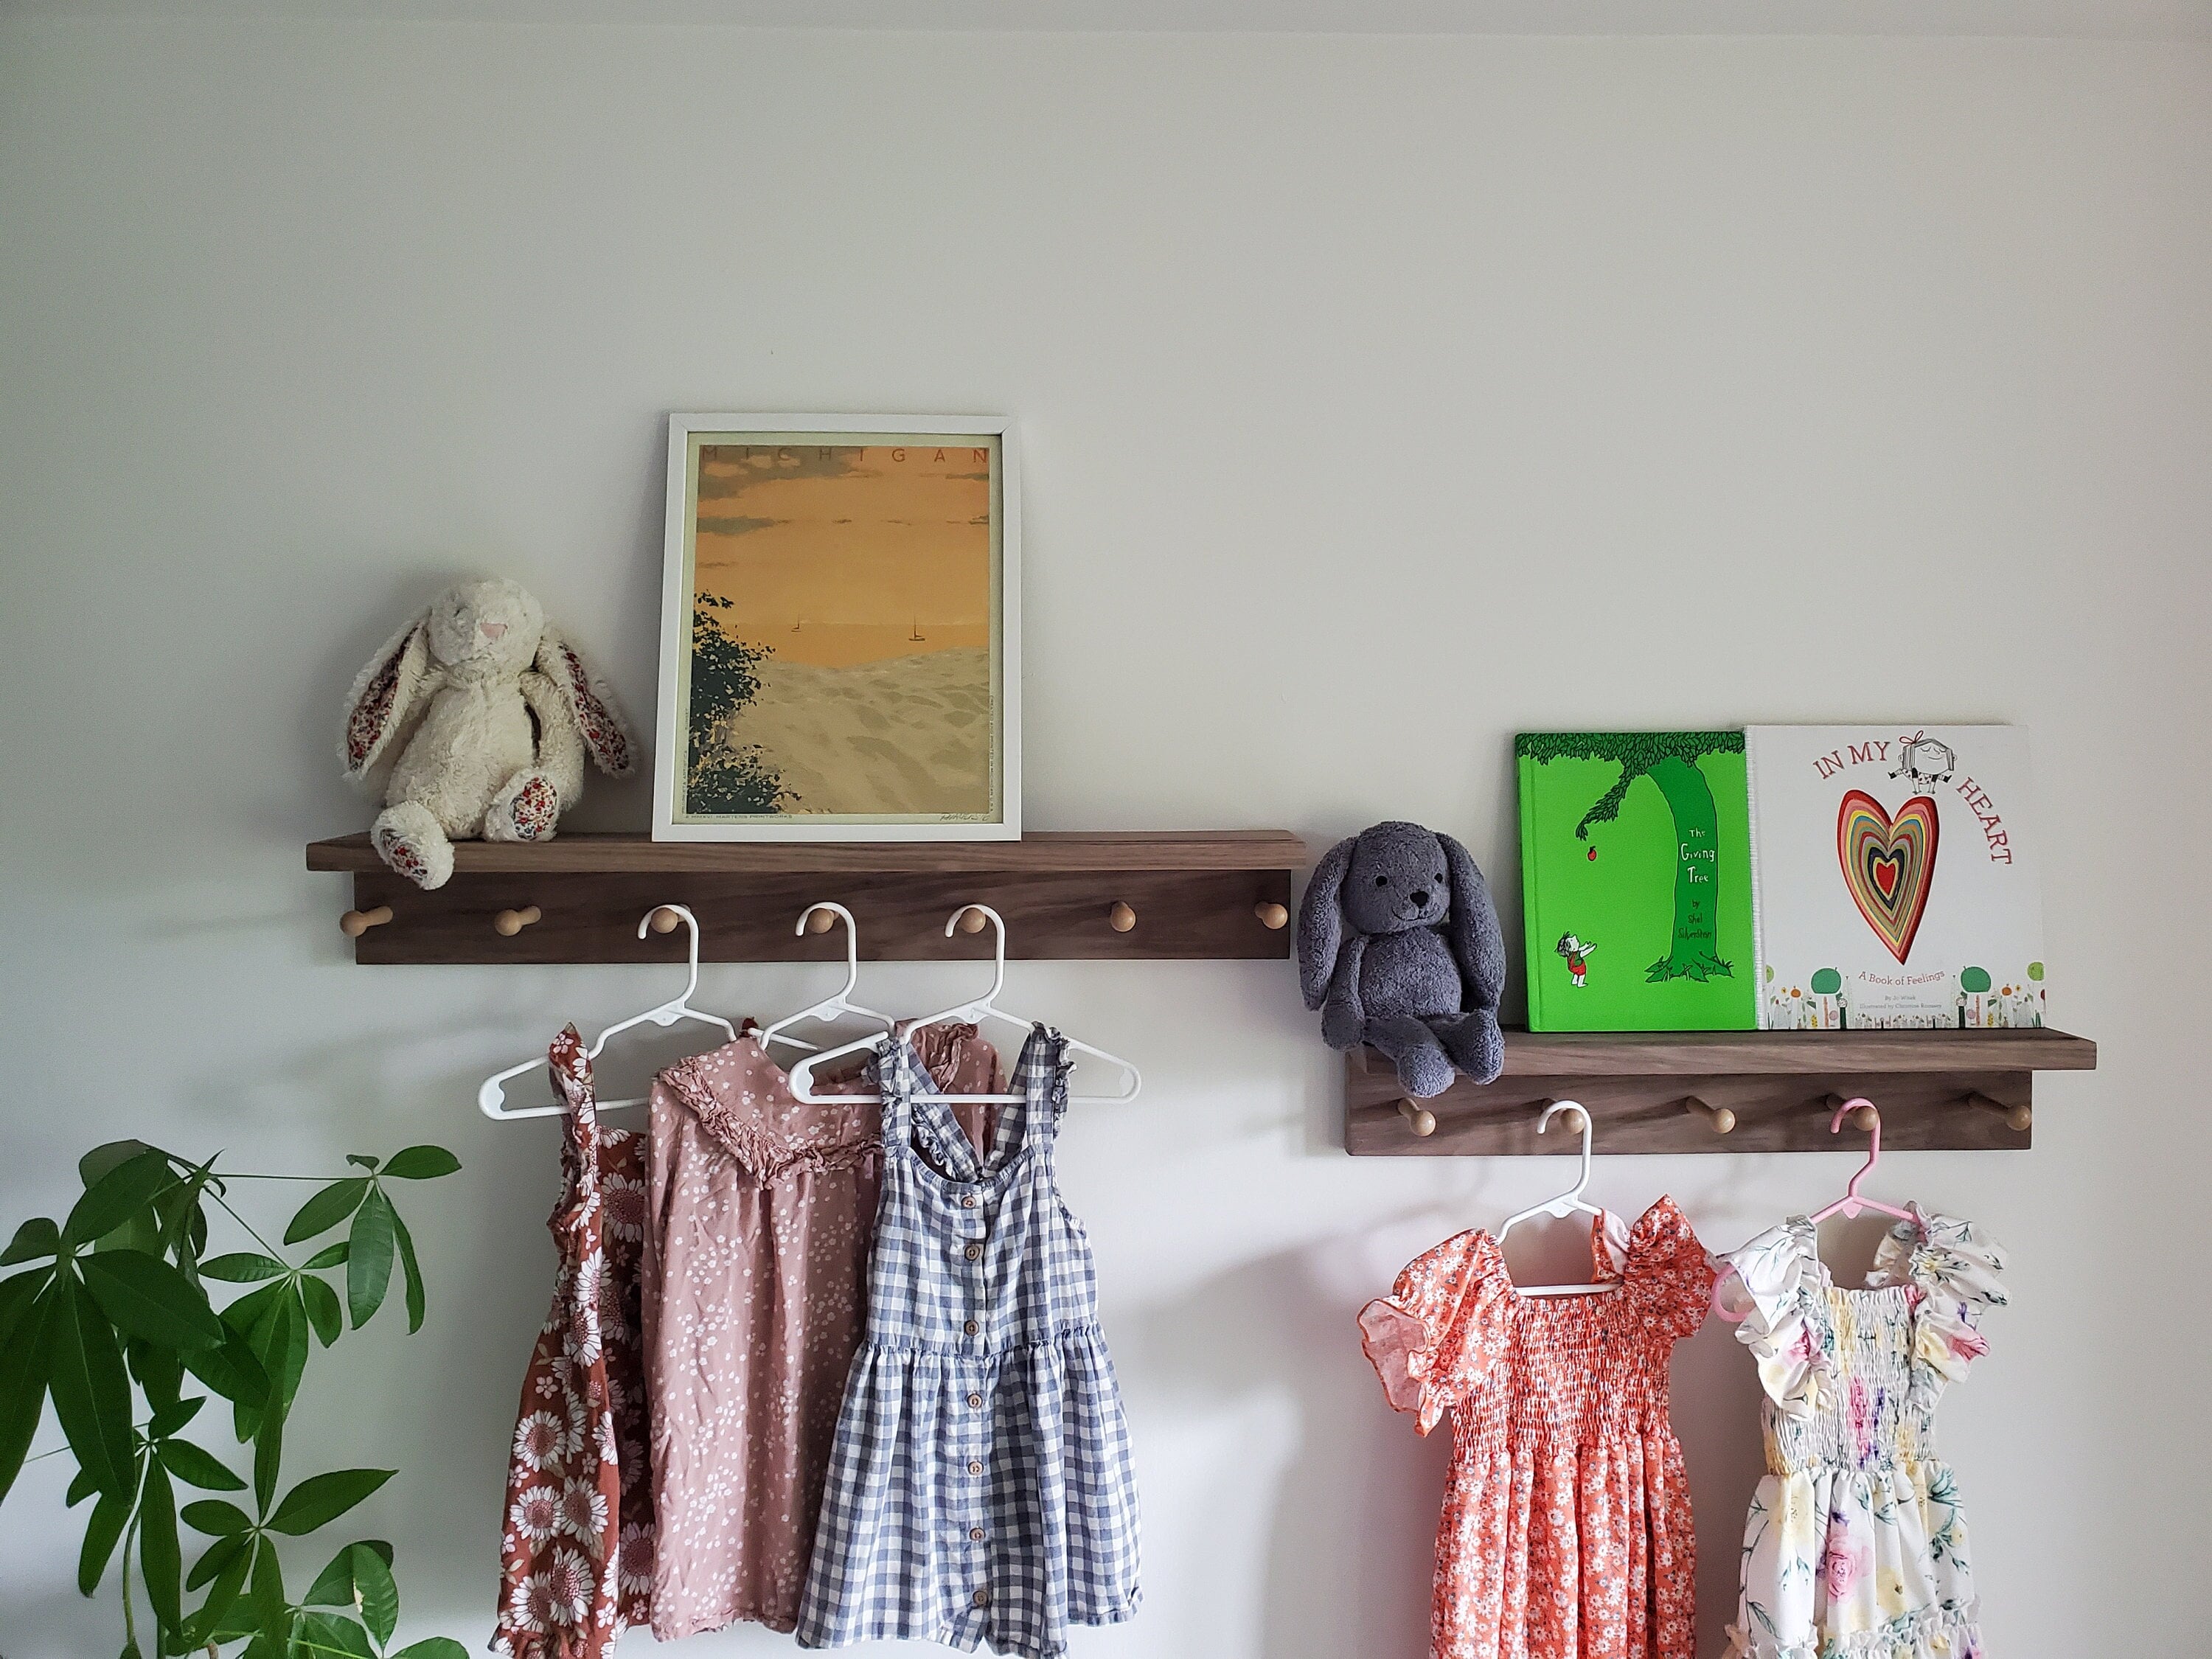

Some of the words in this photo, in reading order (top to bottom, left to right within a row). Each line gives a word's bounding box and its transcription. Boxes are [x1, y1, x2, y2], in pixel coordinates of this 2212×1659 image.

[702, 446, 988, 463] MICHIGAN
[1812, 749, 1845, 779] IN
[1847, 741, 1891, 765] MY
[1955, 776, 2013, 866] HEART
[1688, 827, 1705, 838] The
[1680, 844, 1715, 862] Giving
[1687, 866, 1709, 883] Tree
[1691, 900, 1700, 909] by
[1688, 913, 1703, 924] Shel
[1858, 971, 1866, 981] A
[1868, 973, 1893, 985] Book
[1895, 976, 1905, 985] of
[1907, 970, 1945, 985] Feelings
